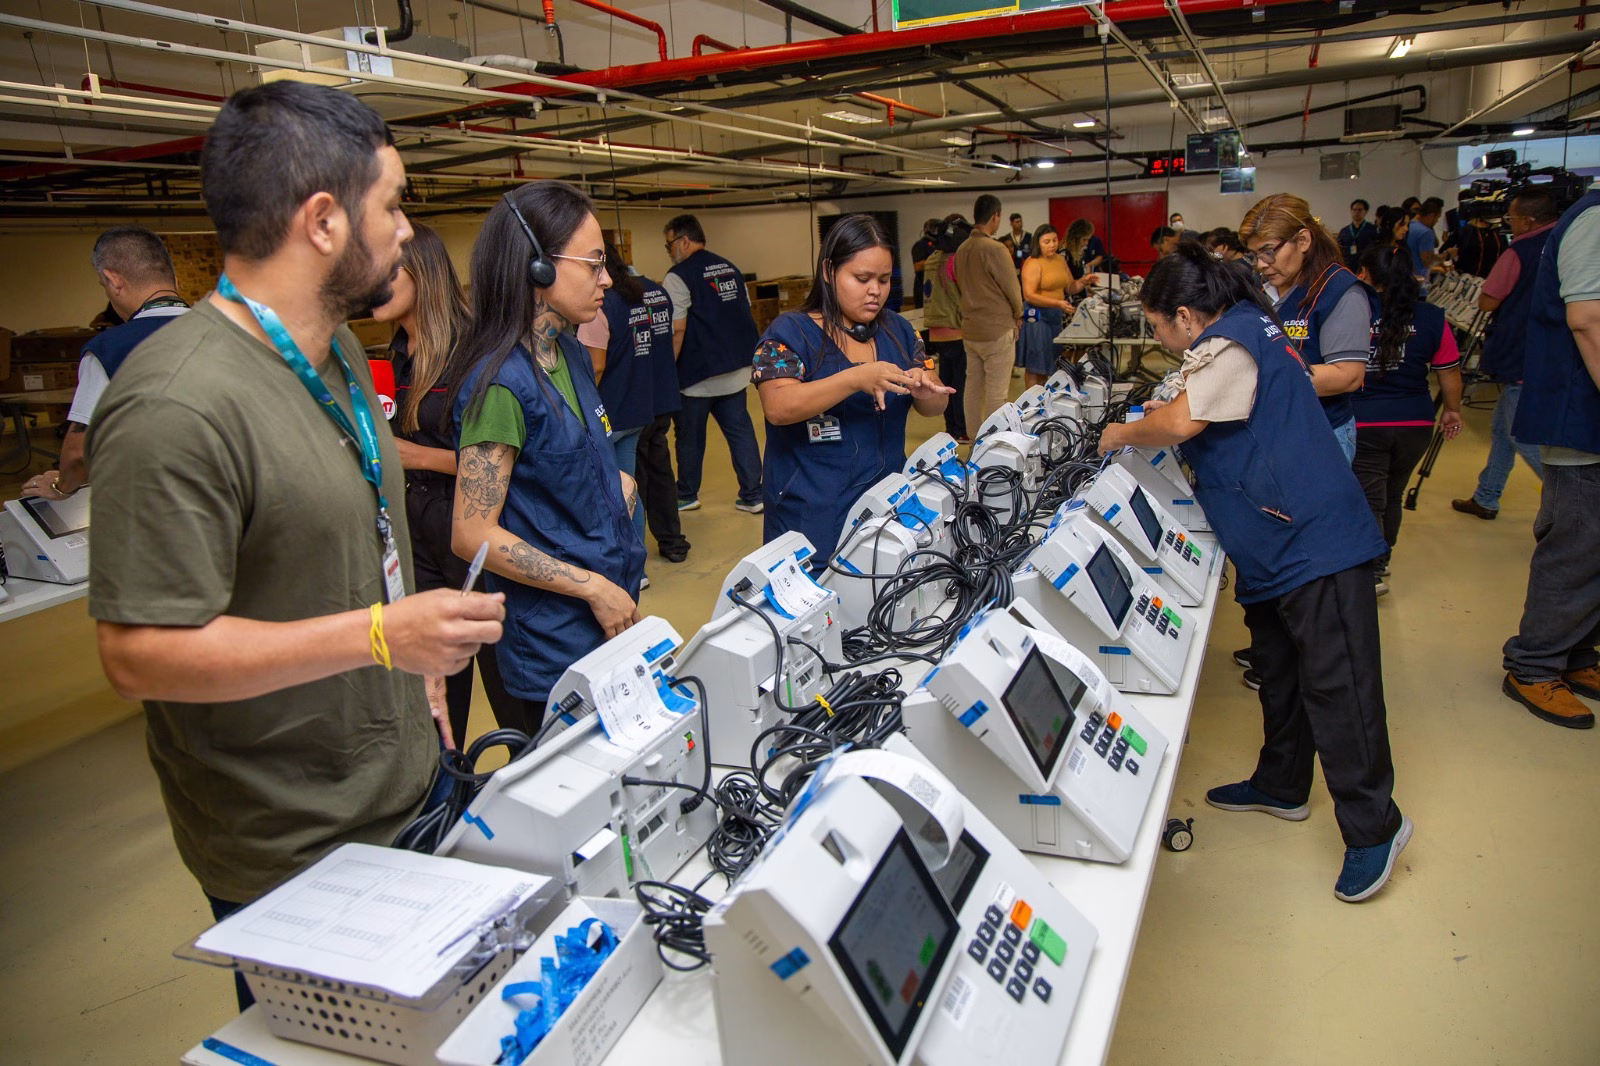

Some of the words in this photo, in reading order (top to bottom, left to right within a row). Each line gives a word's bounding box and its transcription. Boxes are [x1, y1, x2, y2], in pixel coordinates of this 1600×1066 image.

[619, 682, 631, 696] 59
[972, 947, 982, 956] 1
[981, 928, 990, 939] 2
[989, 911, 998, 921] 3
[992, 966, 1000, 975] 4
[999, 947, 1009, 957] 5
[1007, 930, 1016, 939] 6
[1010, 984, 1020, 995] 7
[1037, 985, 1046, 995] 0
